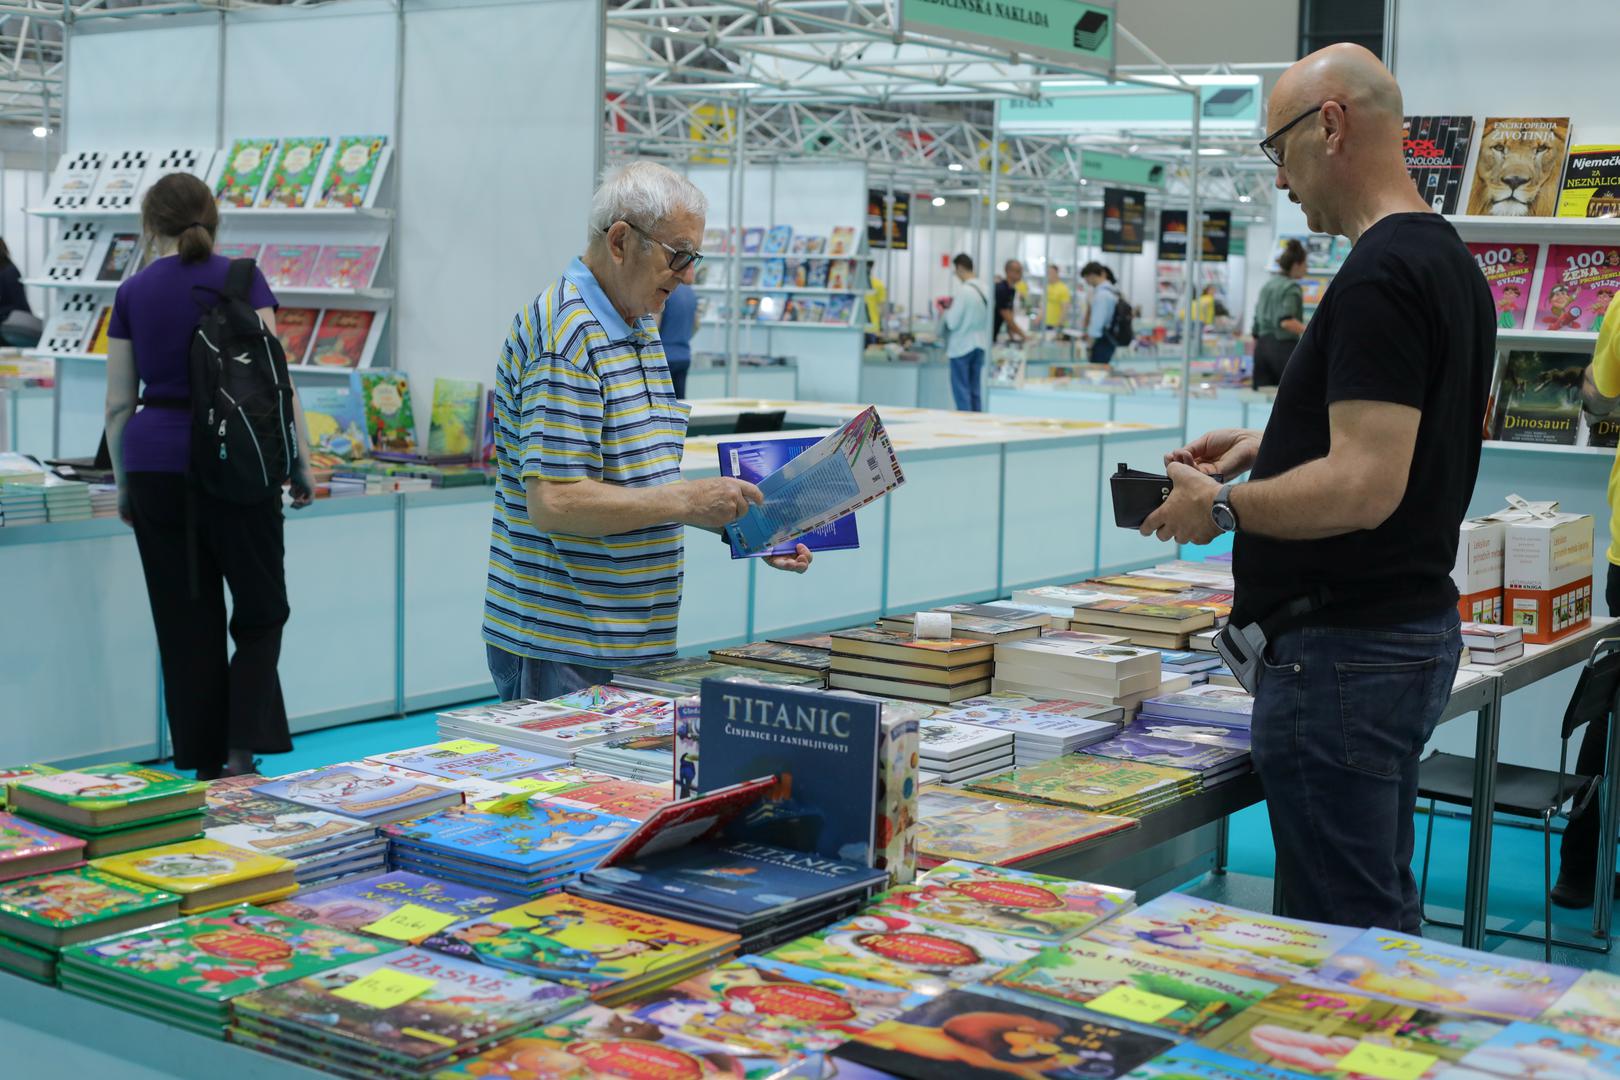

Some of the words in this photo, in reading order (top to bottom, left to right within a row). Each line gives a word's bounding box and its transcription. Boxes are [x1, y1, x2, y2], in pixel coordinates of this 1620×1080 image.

[999, 3, 1049, 28] NAKLADA
[1494, 121, 1558, 130] ENCIKLOPEDIJA
[1491, 129, 1557, 141] ŽIVOTINJA
[1402, 139, 1436, 150] OCK
[1404, 156, 1452, 166] ONOLOGIJA
[1413, 148, 1445, 158] POP
[1474, 248, 1512, 268] 100
[1566, 250, 1605, 272] 100
[1480, 263, 1506, 277] ENA
[1562, 266, 1600, 282] ŽENA
[1496, 276, 1527, 287] SVIJET
[1504, 415, 1571, 430] Dinosauri
[722, 694, 851, 739] TITANIC
[724, 723, 771, 742] ČINJENICE
[773, 734, 778, 742] I
[779, 735, 849, 753] ZANIMLJIVOSTI
[731, 841, 858, 875] TITANIC
[386, 952, 513, 993] BASNE
[1120, 957, 1193, 978] NJEGOV
